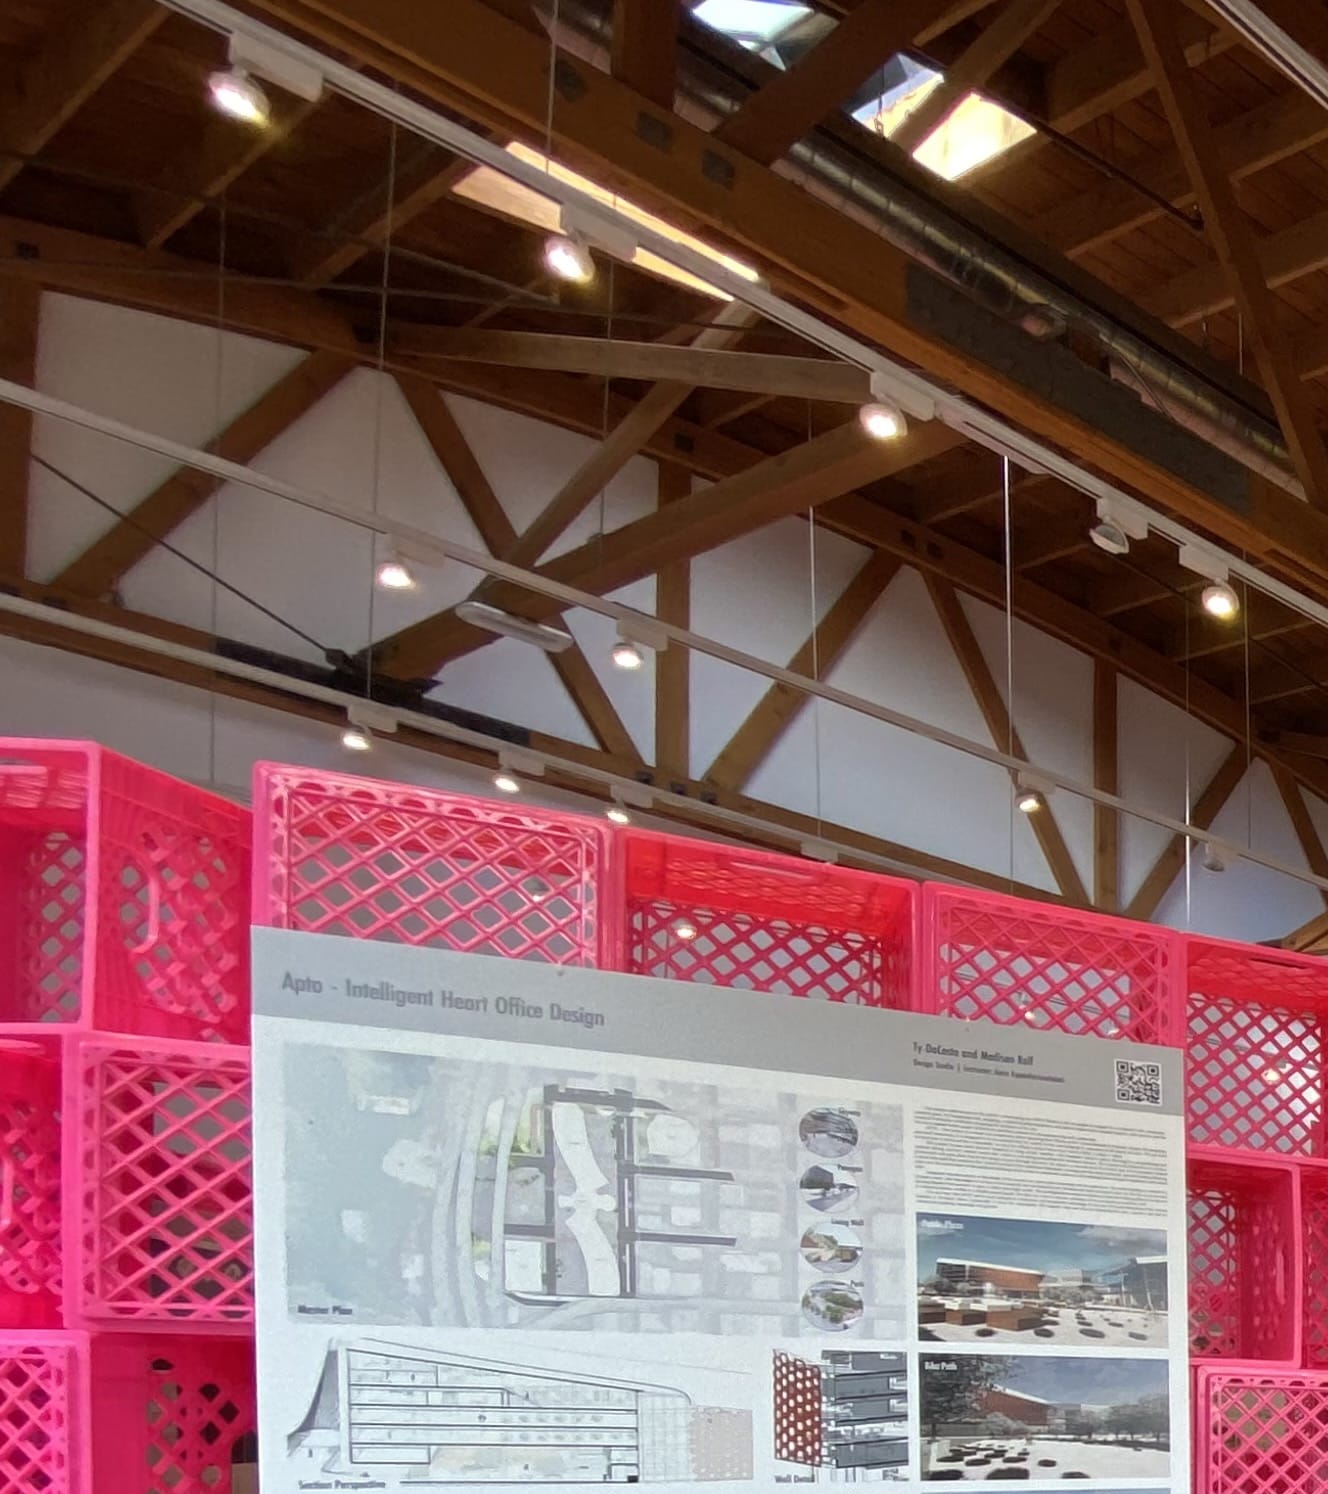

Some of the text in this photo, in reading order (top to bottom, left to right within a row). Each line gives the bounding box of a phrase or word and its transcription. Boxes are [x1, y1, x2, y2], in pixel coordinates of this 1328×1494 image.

[282, 971, 323, 996] Apto
[345, 978, 434, 1007] Intelligent
[441, 990, 488, 1012] Heart
[495, 996, 543, 1019] Office
[550, 1003, 605, 1028] Design
